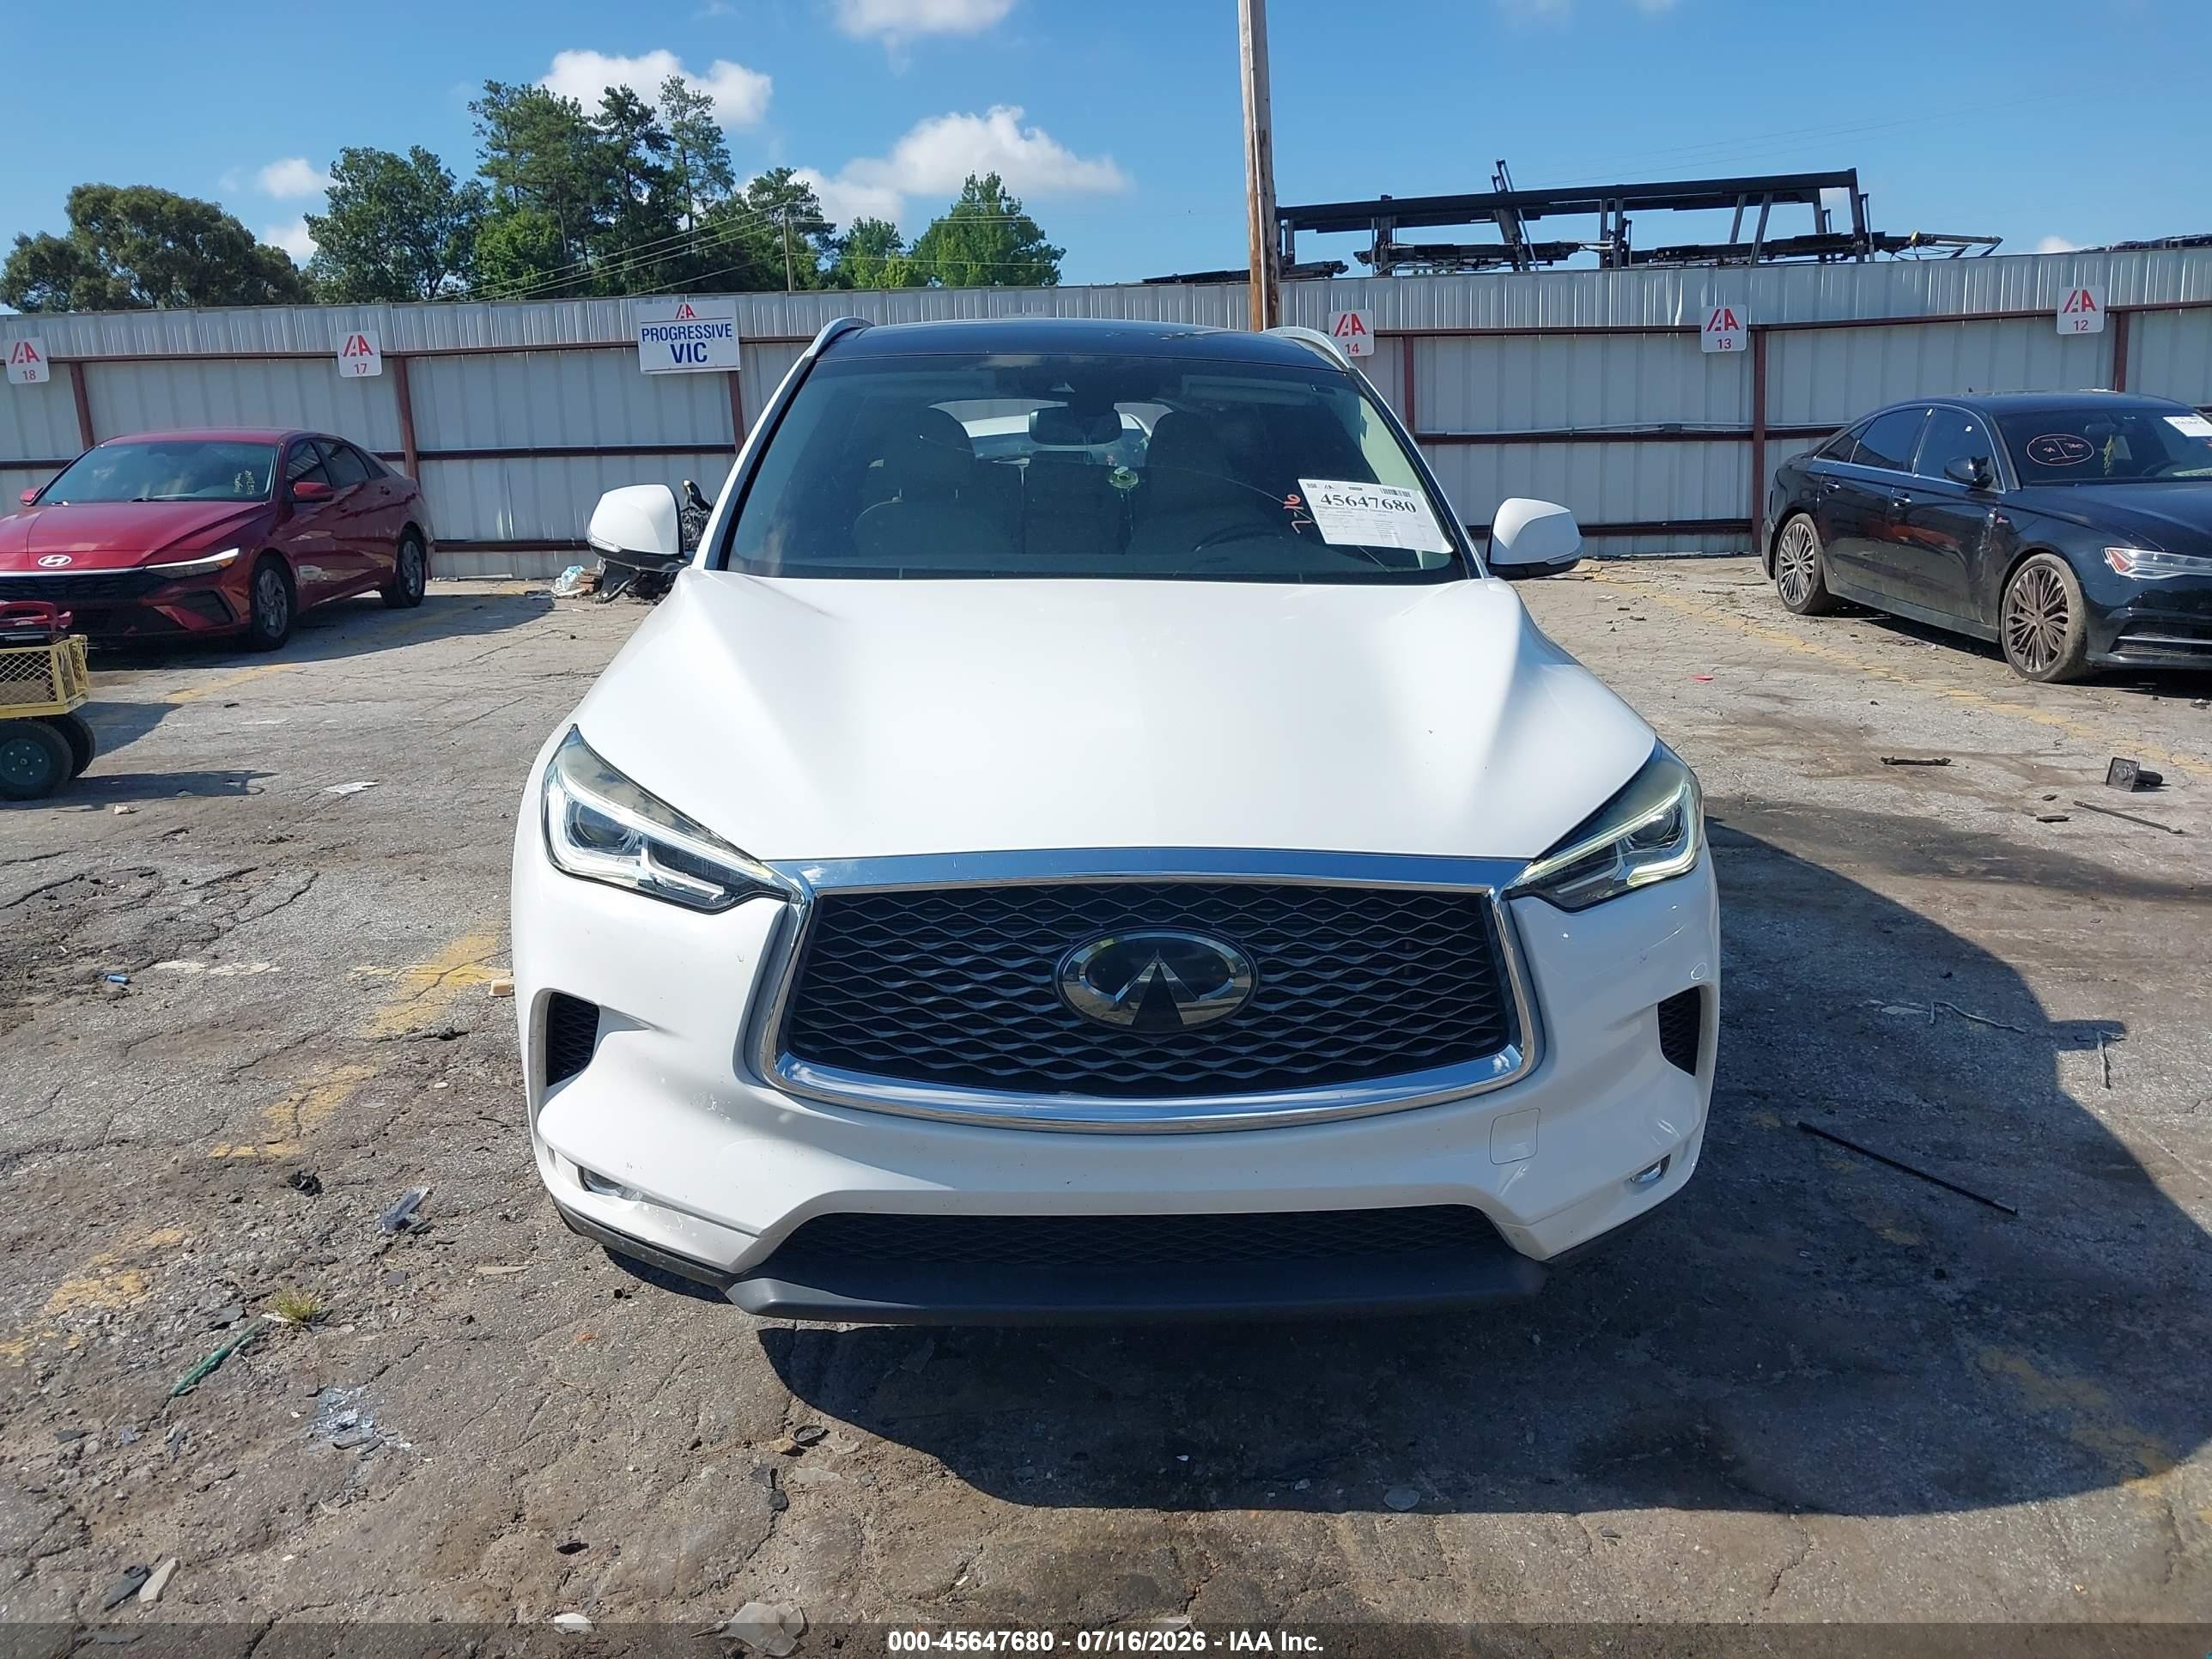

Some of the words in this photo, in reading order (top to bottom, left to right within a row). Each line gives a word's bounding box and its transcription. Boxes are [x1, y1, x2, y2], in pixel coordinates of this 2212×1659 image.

[2074, 319, 2088, 331] 12
[641, 323, 732, 342] PROGRESSIVE
[1345, 343, 1359, 354] 14
[1717, 337, 1732, 349] 13
[670, 343, 708, 363] VIC
[354, 362, 368, 374] 17
[22, 369, 36, 380] 18
[1320, 493, 1417, 514] 45647680
[1283, 494, 1312, 534] 7-16
